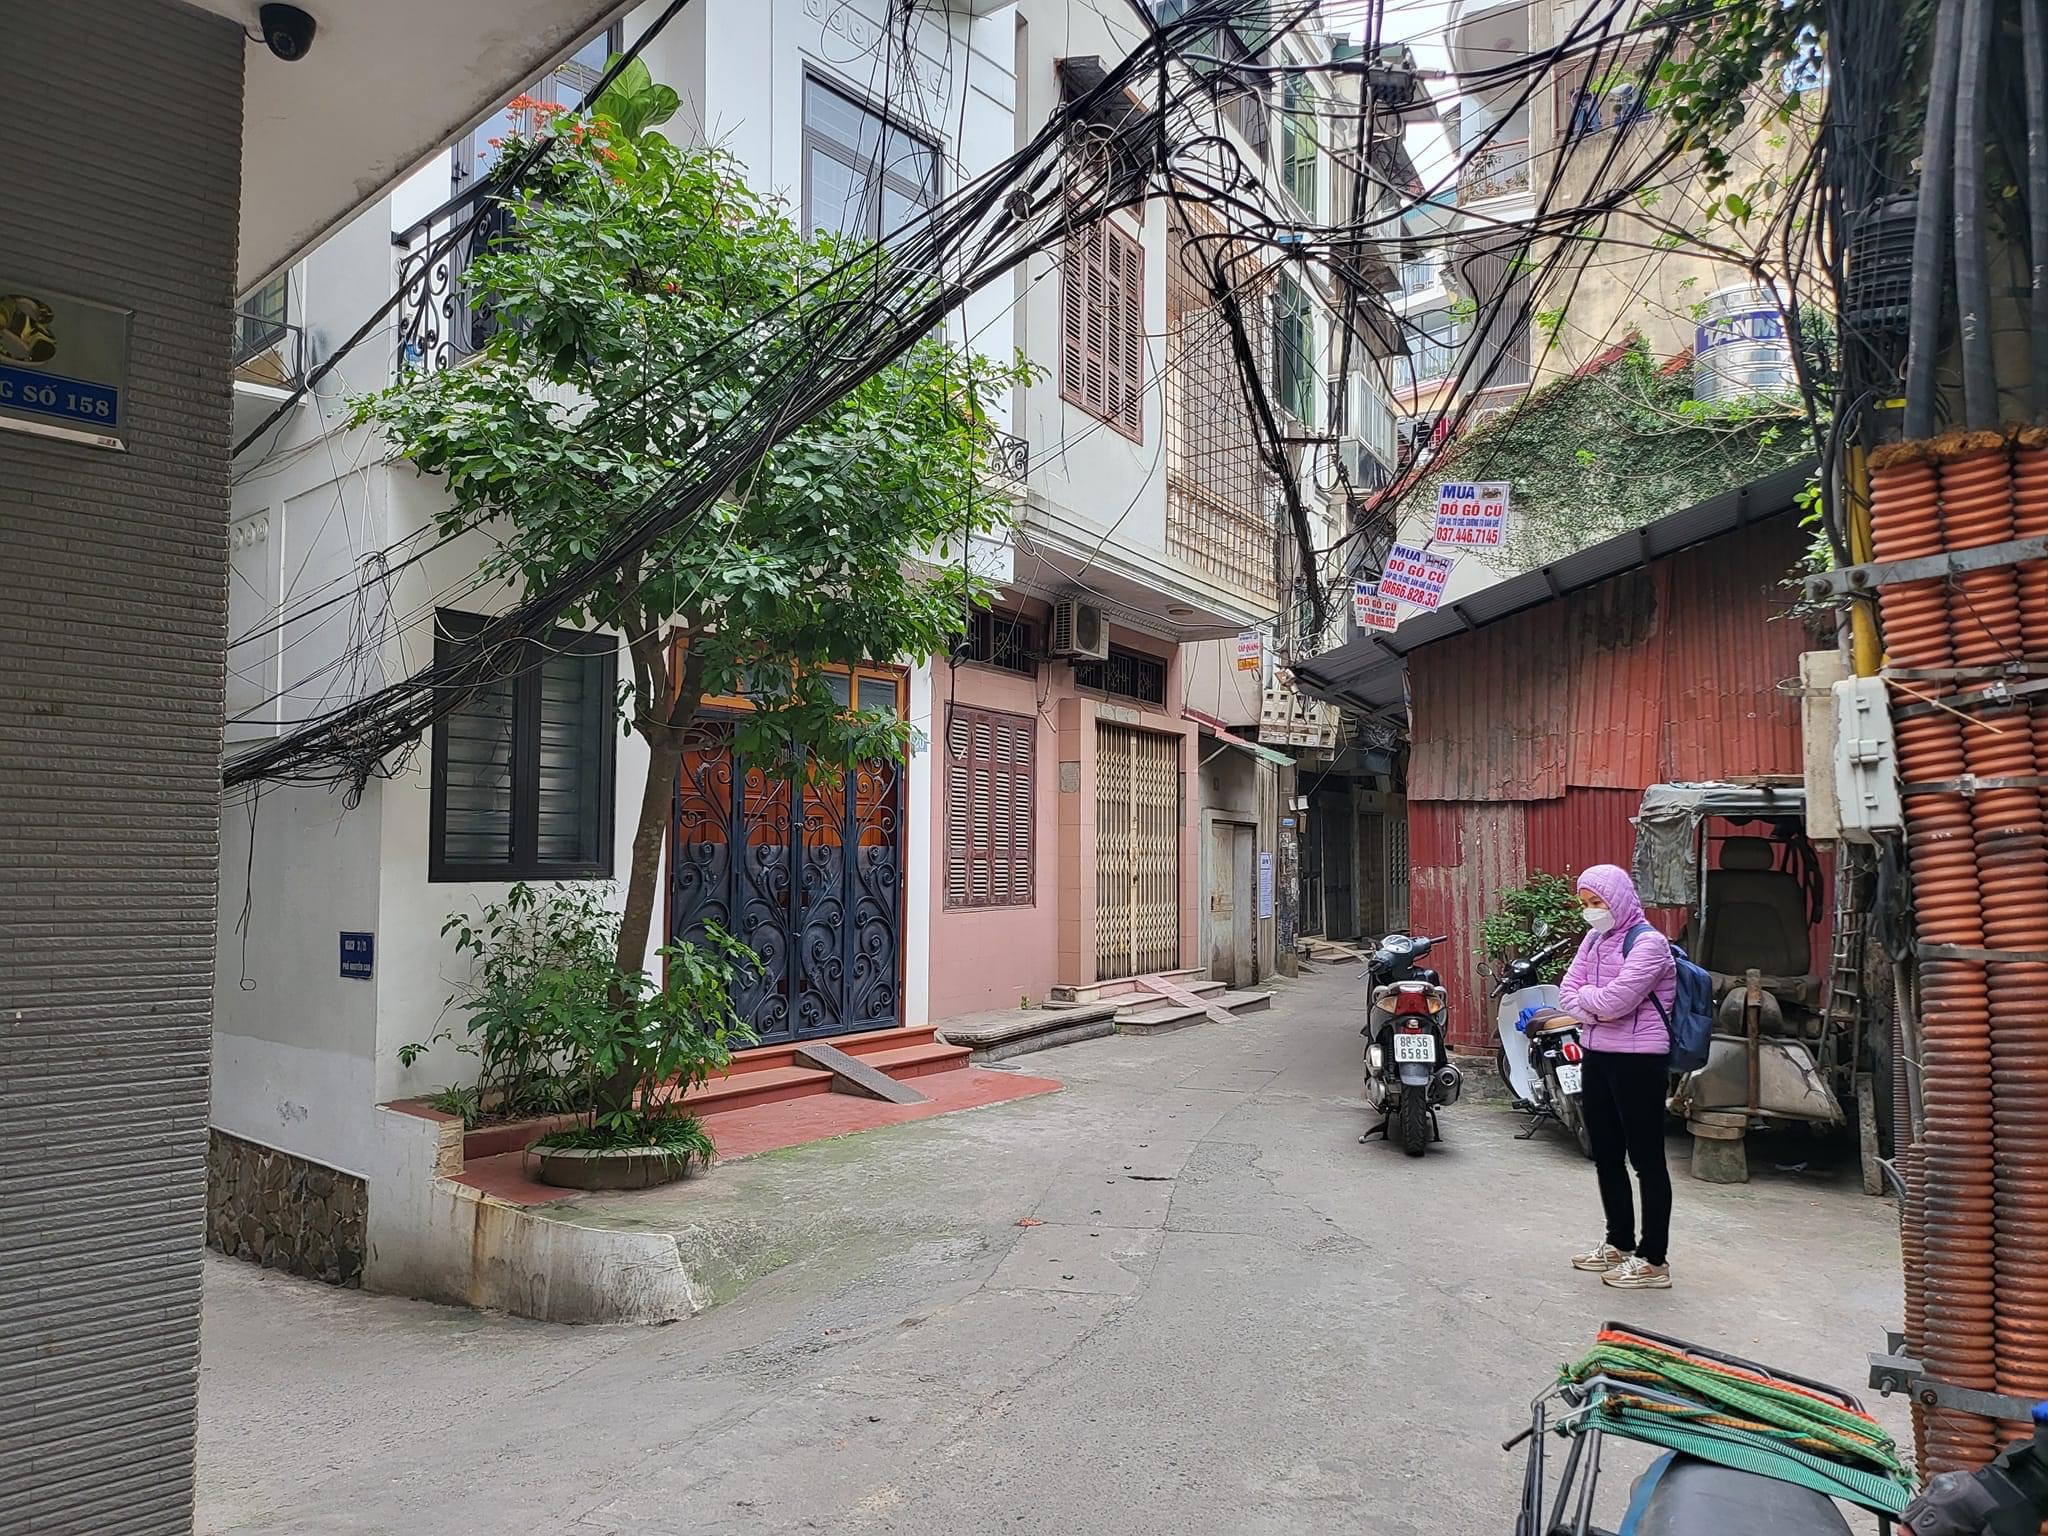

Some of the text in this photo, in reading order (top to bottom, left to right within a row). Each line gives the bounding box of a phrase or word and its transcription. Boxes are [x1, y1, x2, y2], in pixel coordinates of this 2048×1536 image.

[23, 384, 56, 406] SỐ
[66, 394, 110, 417] 158
[1442, 485, 1474, 499] MUA
[1436, 527, 1498, 544] 037.446.7145
[1394, 546, 1421, 562] MUA
[1381, 580, 1438, 607] 08666.828.33
[1401, 1048, 1428, 1059] 6589
